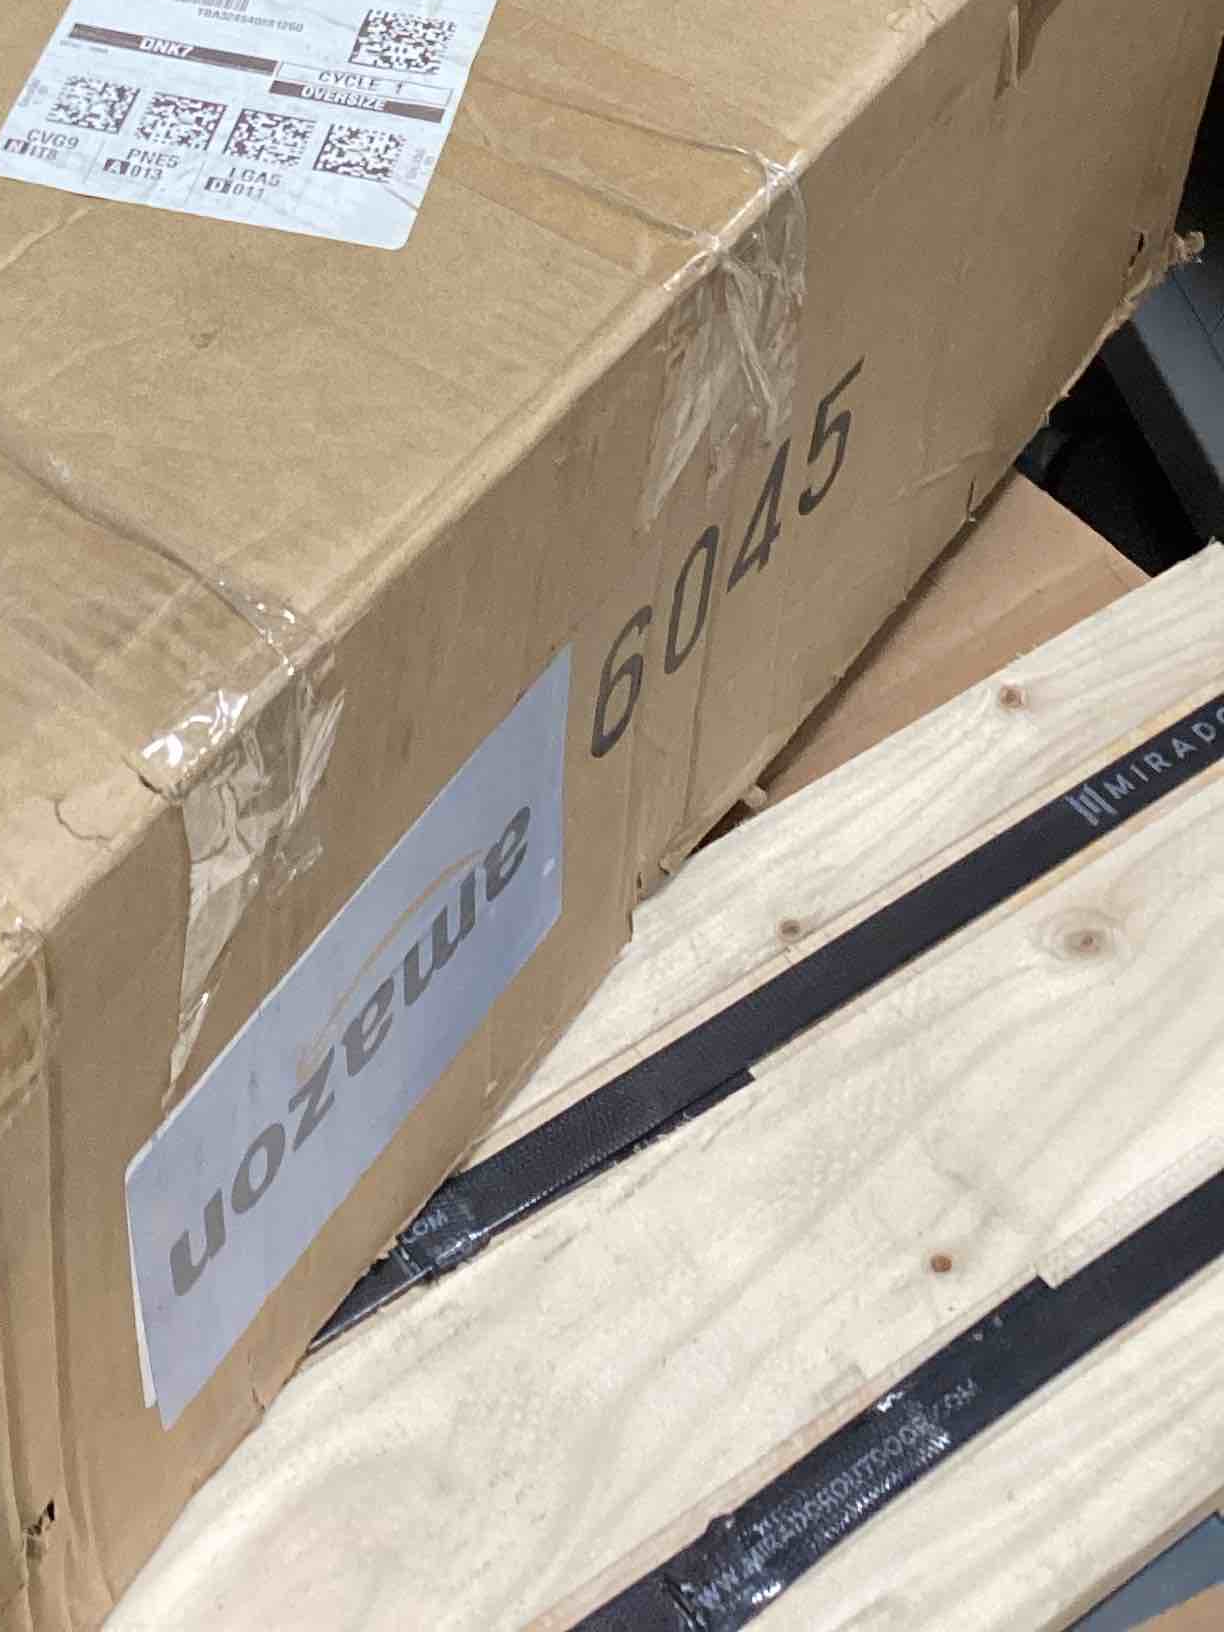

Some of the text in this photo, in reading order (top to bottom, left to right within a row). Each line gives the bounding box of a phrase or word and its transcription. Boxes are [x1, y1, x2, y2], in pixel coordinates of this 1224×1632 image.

[138, 36, 195, 58] DNK7
[300, 84, 385, 112] OVERSIZE
[27, 128, 79, 149] CVG9
[590, 355, 866, 758] 6045
[169, 805, 532, 1297] amazon
